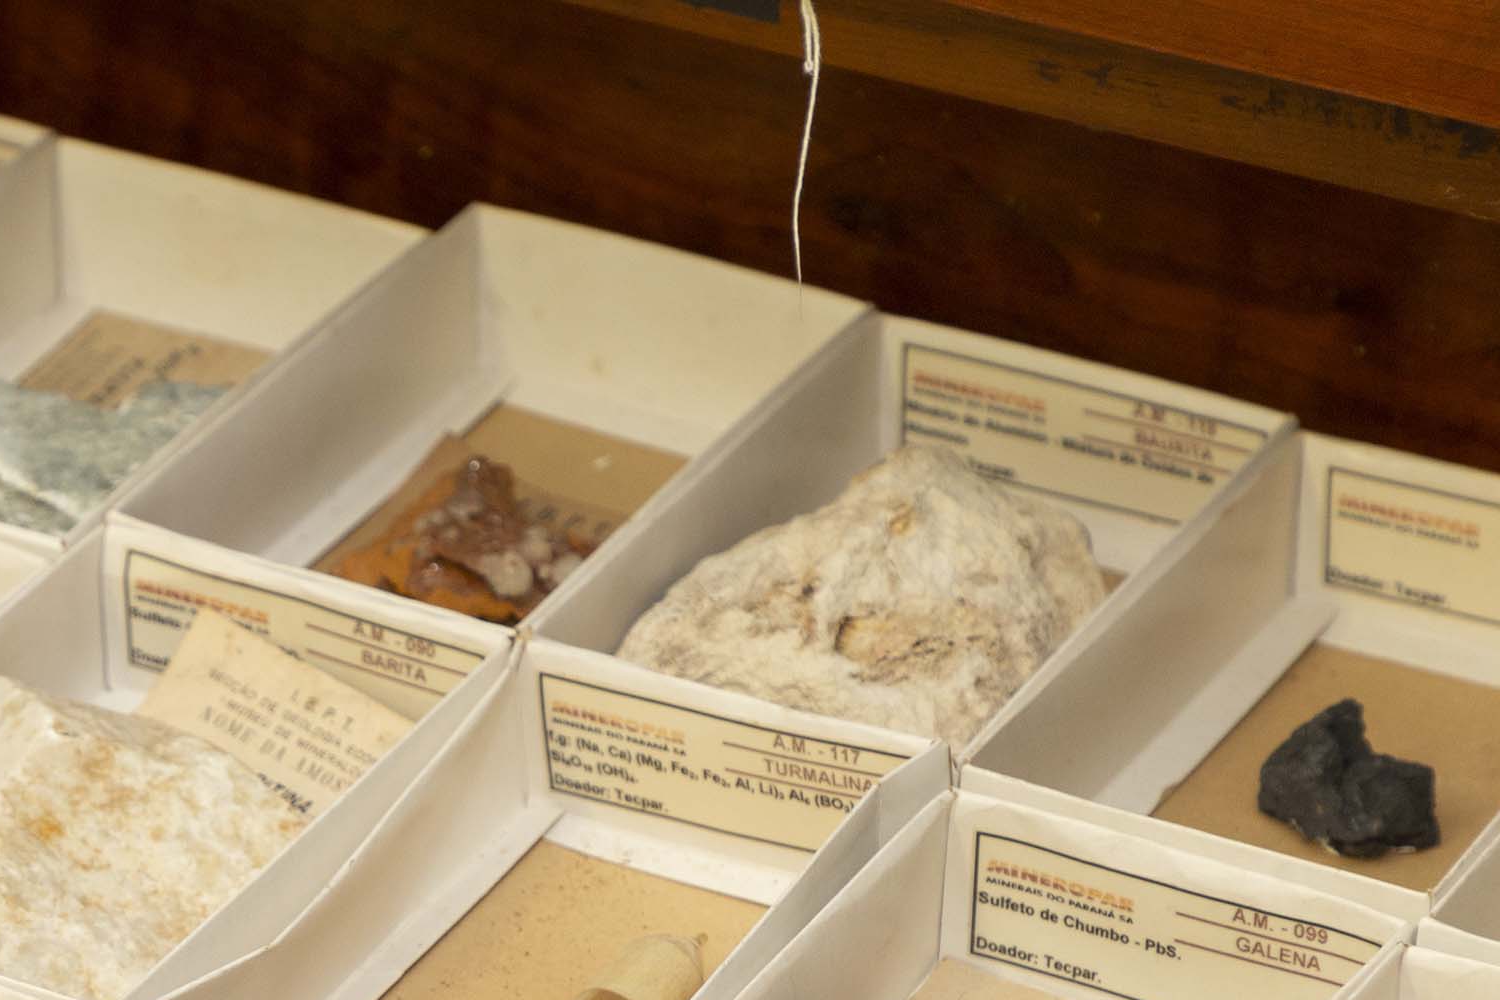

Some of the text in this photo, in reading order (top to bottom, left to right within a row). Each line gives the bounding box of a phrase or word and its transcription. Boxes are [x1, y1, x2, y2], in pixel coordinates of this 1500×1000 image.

[361, 649, 429, 684] BARITA
[552, 701, 685, 745] MINEROPAR
[773, 734, 810, 754] A.M.
[830, 745, 861, 765] 117
[554, 772, 669, 812] Doador: Tecpar.
[764, 758, 874, 793] TURMALINA
[986, 876, 1134, 925] MINERAIS DO PARANÁ SA
[987, 858, 1134, 912] MINEROPAR
[978, 890, 1035, 916] Sulfeto
[1040, 908, 1059, 924] de
[1063, 915, 1130, 945] Chumbo
[1145, 938, 1181, 960] PbS.
[1232, 908, 1274, 932] A.M.
[1294, 922, 1329, 945] 099
[976, 936, 1102, 983] Doador: Tecpar.
[1236, 935, 1321, 972] GALENA
